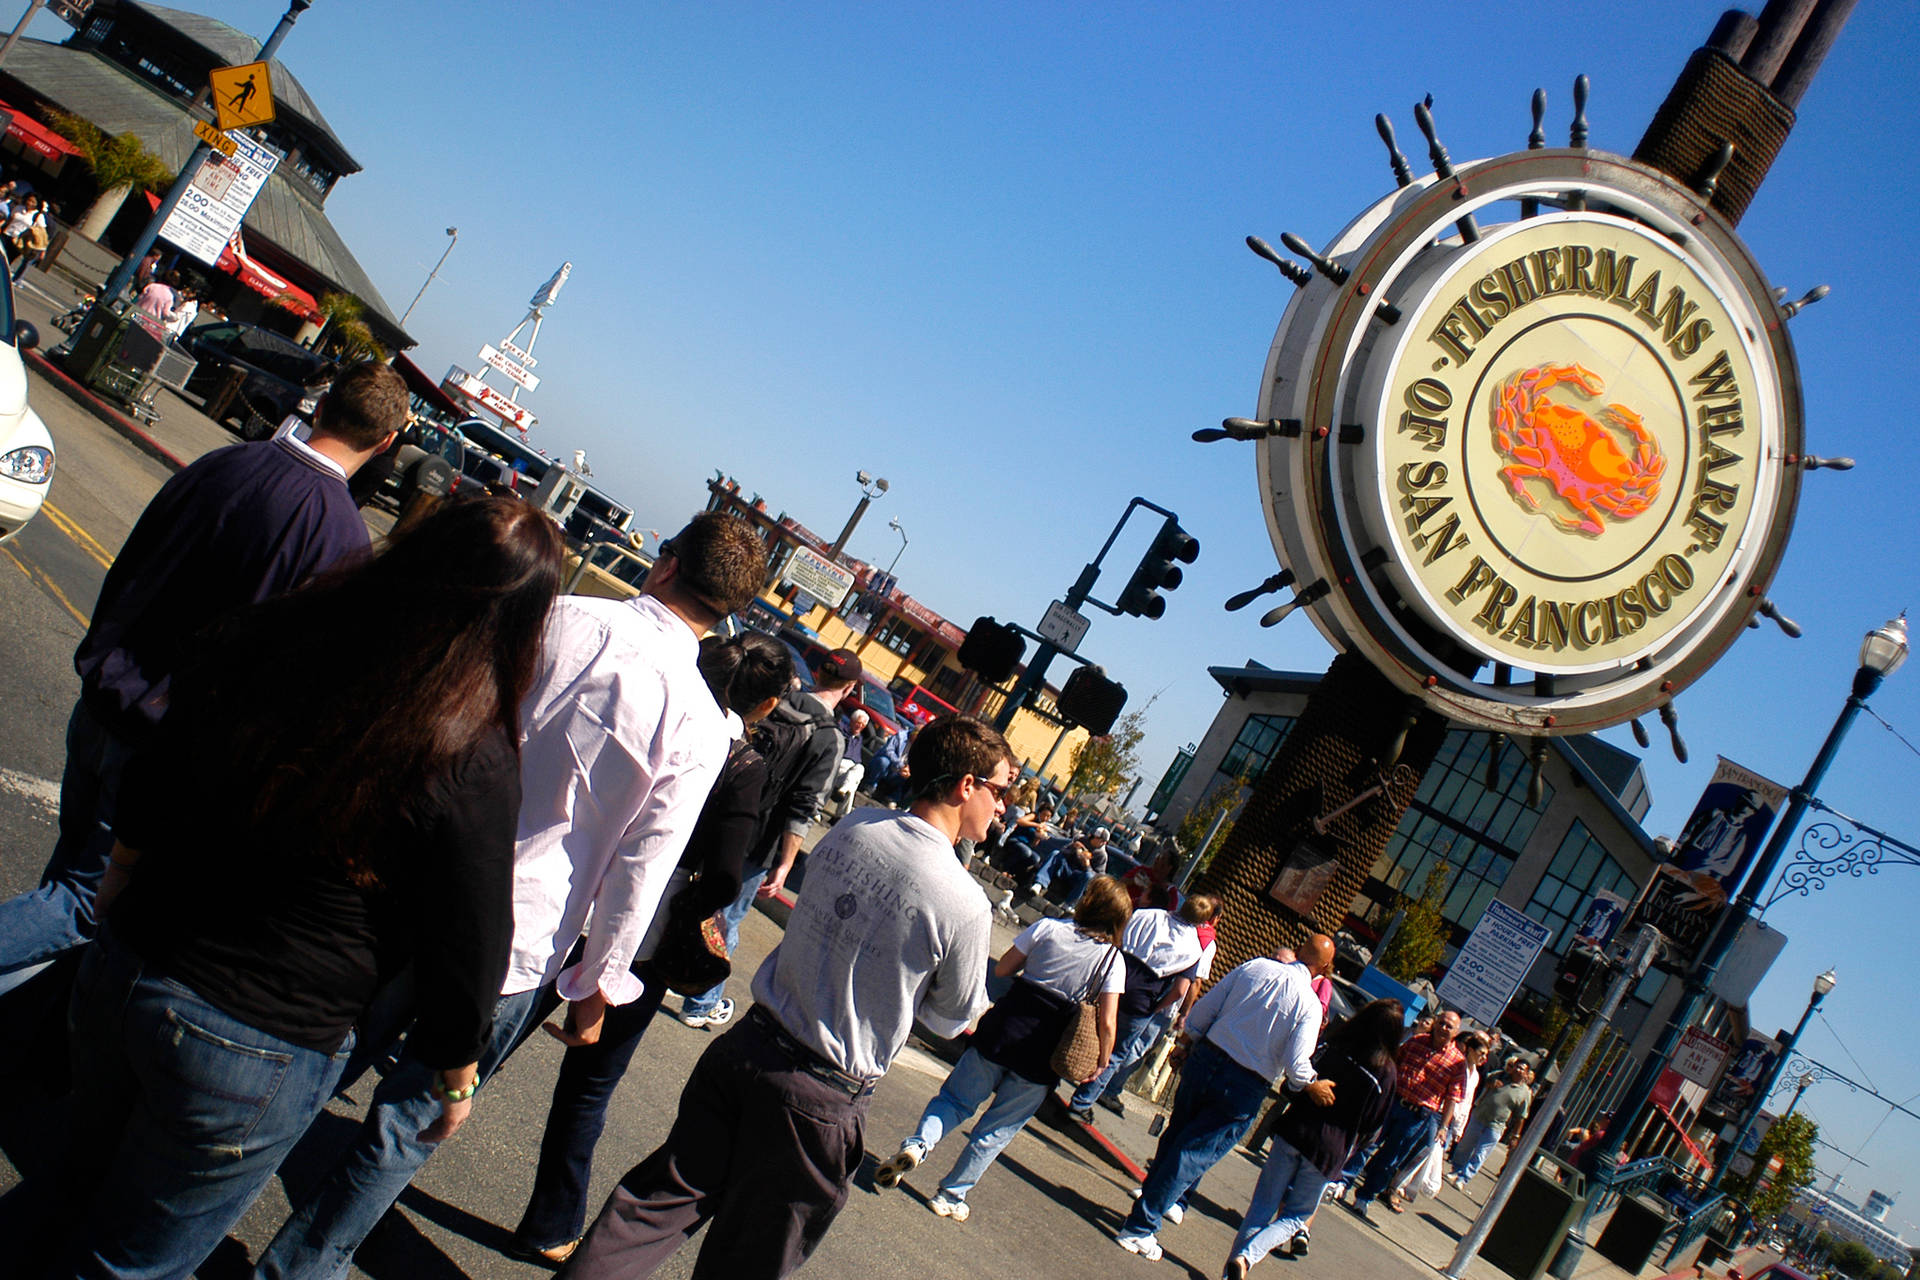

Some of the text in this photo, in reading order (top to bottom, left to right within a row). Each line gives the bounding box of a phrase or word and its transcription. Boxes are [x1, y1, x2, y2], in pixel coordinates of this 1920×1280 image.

[200, 125, 230, 151] XING
[244, 164, 263, 179] FREE
[1427, 244, 1744, 555] FISHERMANS WHARF
[1398, 376, 1696, 652] OF SAN FRANCISCO
[1488, 927, 1522, 950] PARKING
[1491, 920, 1518, 939] HOURS
[1517, 935, 1535, 950] FREE
[1682, 1057, 1705, 1076] TIME
[1687, 1050, 1708, 1067] ANY
